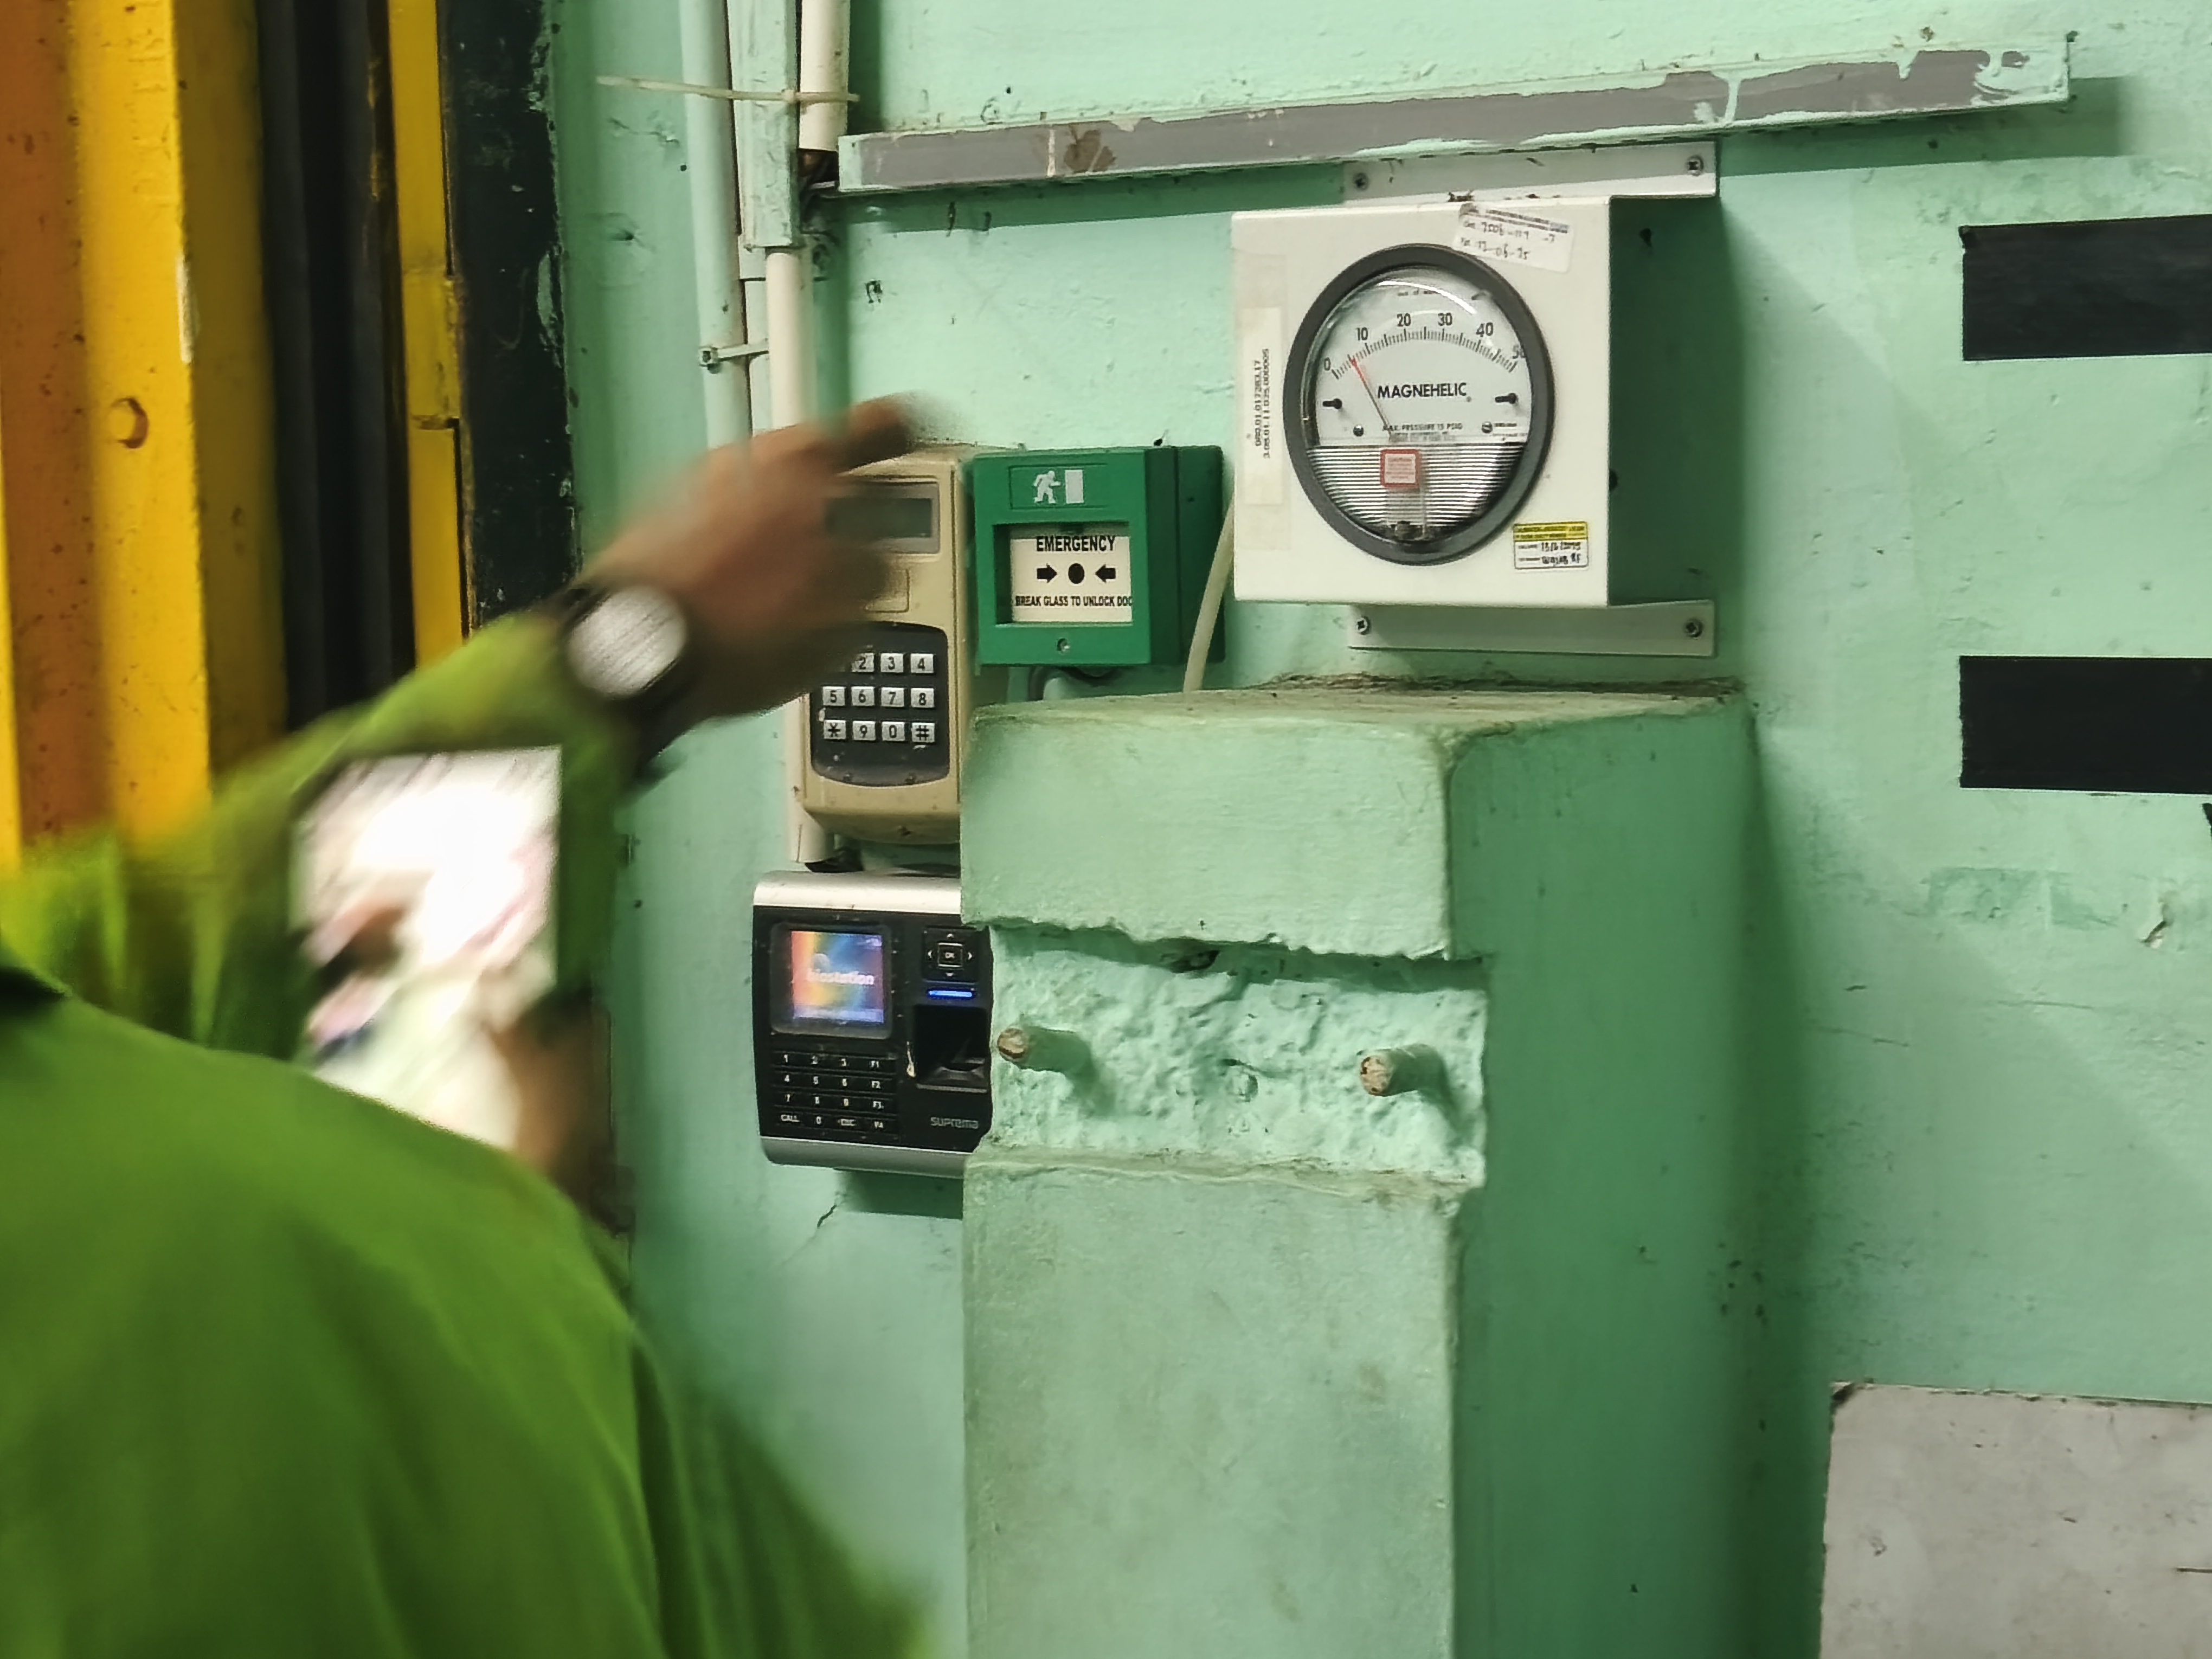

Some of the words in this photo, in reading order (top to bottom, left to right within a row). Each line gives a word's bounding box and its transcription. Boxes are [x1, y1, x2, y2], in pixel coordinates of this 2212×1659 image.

[1397, 313, 1411, 326] 20
[1438, 312, 1453, 326] 30
[1356, 327, 1368, 340] 10
[1476, 322, 1494, 337] 40
[1323, 357, 1331, 371] 0
[1378, 382, 1467, 398] MAGNEHELIC
[1037, 535, 1116, 552] EMERGENCY
[1015, 596, 1041, 606] BREAK
[1044, 596, 1068, 606] GLASS
[1072, 596, 1081, 606] TO
[1083, 596, 1114, 606] UNLOCK
[859, 657, 866, 670] 2
[888, 657, 895, 670] 3
[917, 658, 925, 669] 4
[829, 690, 838, 703] 5
[858, 690, 866, 703] 6
[889, 692, 896, 708] 7
[918, 692, 927, 705] 8
[859, 725, 867, 738] 9
[889, 725, 897, 738] 0
[784, 1054, 788, 1063] 1
[812, 1055, 818, 1064] 2
[841, 1058, 847, 1066] 3
[813, 1076, 819, 1084] 5
[842, 1078, 847, 1086] 6
[815, 1096, 820, 1104] 8
[816, 1116, 822, 1124] 0
